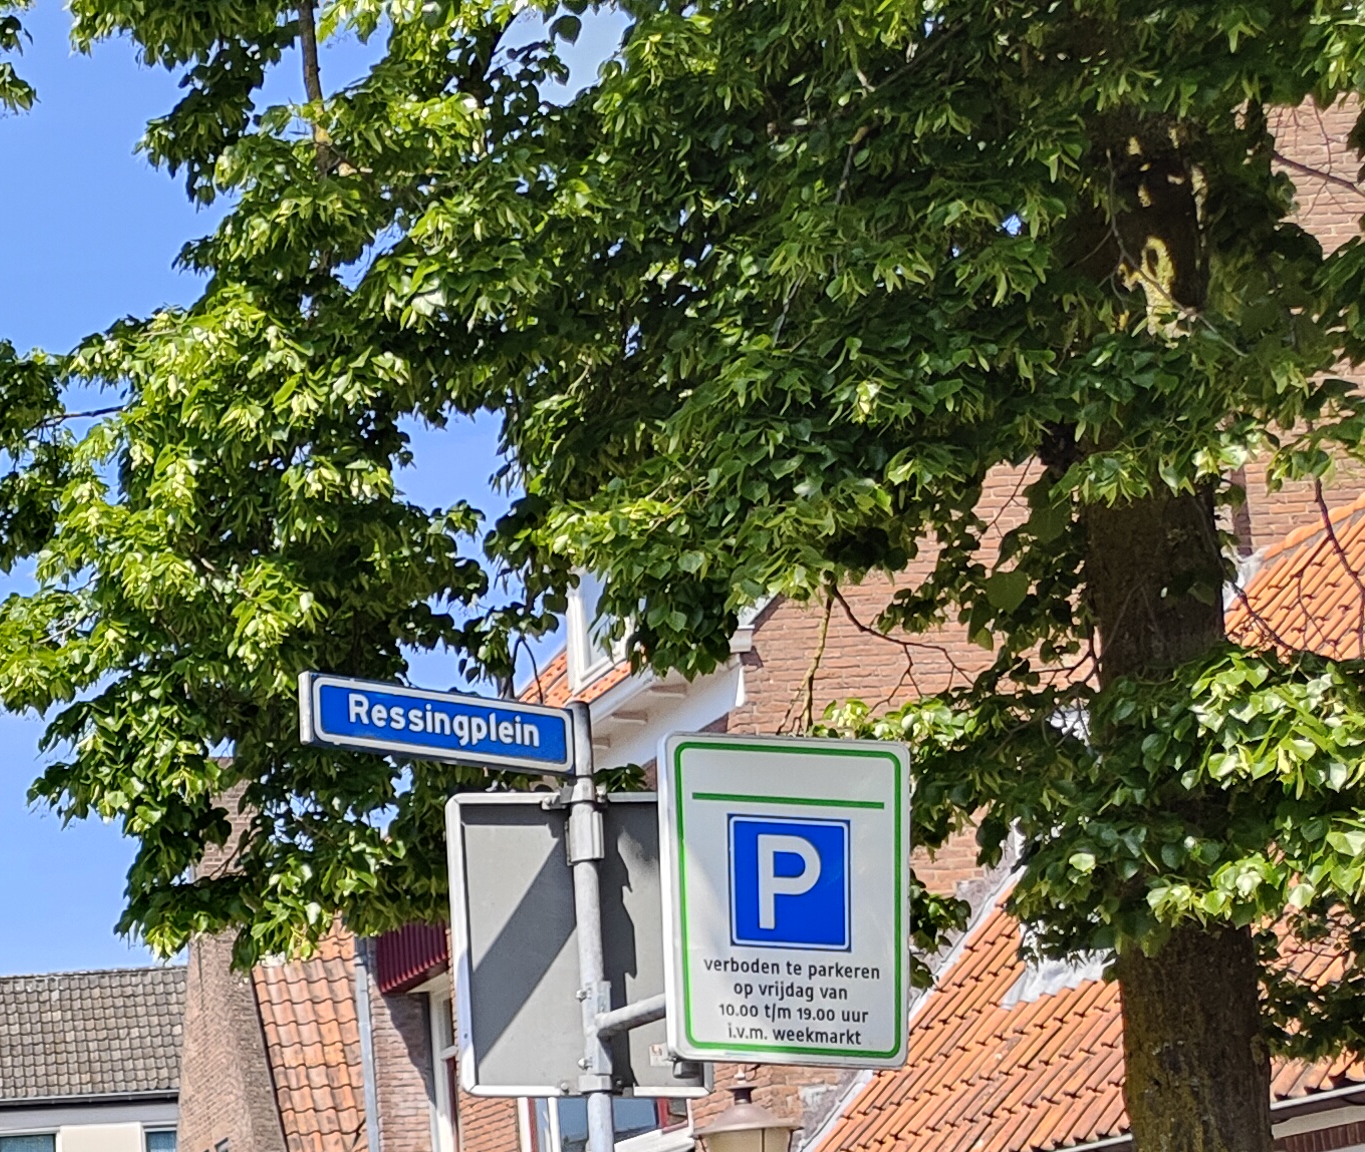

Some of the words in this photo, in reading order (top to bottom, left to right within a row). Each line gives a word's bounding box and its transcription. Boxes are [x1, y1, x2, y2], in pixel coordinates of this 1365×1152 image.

[348, 692, 540, 747] Ressingplein
[703, 957, 780, 975] verboden
[786, 961, 802, 976] te
[808, 962, 880, 980] parkeren
[733, 982, 753, 998] op
[758, 981, 814, 1002] vrijdag
[819, 987, 848, 1001] van
[719, 1003, 759, 1018] 10.00
[764, 1003, 792, 1022] t/m
[797, 1007, 836, 1021] 19.00
[841, 1010, 869, 1023] uur
[727, 1023, 768, 1040] i.v.m.
[772, 1026, 862, 1045] weekmarkt
